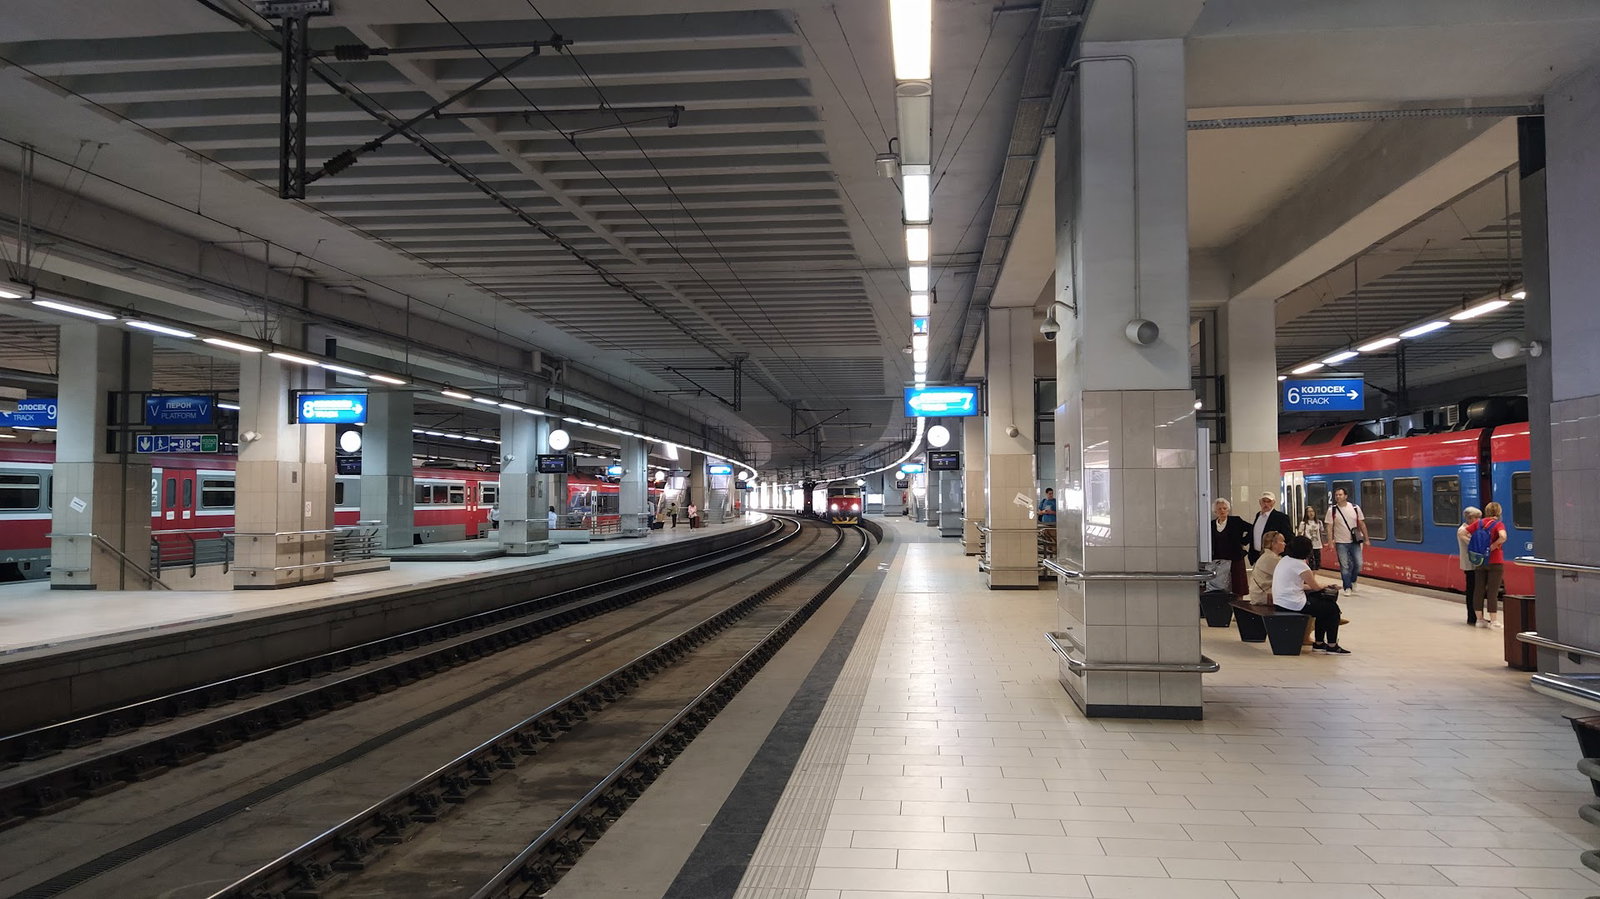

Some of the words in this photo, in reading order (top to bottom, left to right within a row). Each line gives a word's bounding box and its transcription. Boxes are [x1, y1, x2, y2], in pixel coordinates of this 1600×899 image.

[1287, 387, 1300, 404] 6
[1301, 385, 1346, 394] КОЛОСЕК
[1302, 397, 1330, 405] TRACK
[47, 404, 57, 420] 9
[150, 404, 160, 417] V
[161, 412, 197, 420] PLATFORM
[198, 403, 208, 416] V
[303, 401, 315, 418] 8
[179, 440, 184, 449] 9
[187, 440, 191, 449] 8
[151, 478, 158, 495] 2
[1328, 491, 1333, 504] 2
